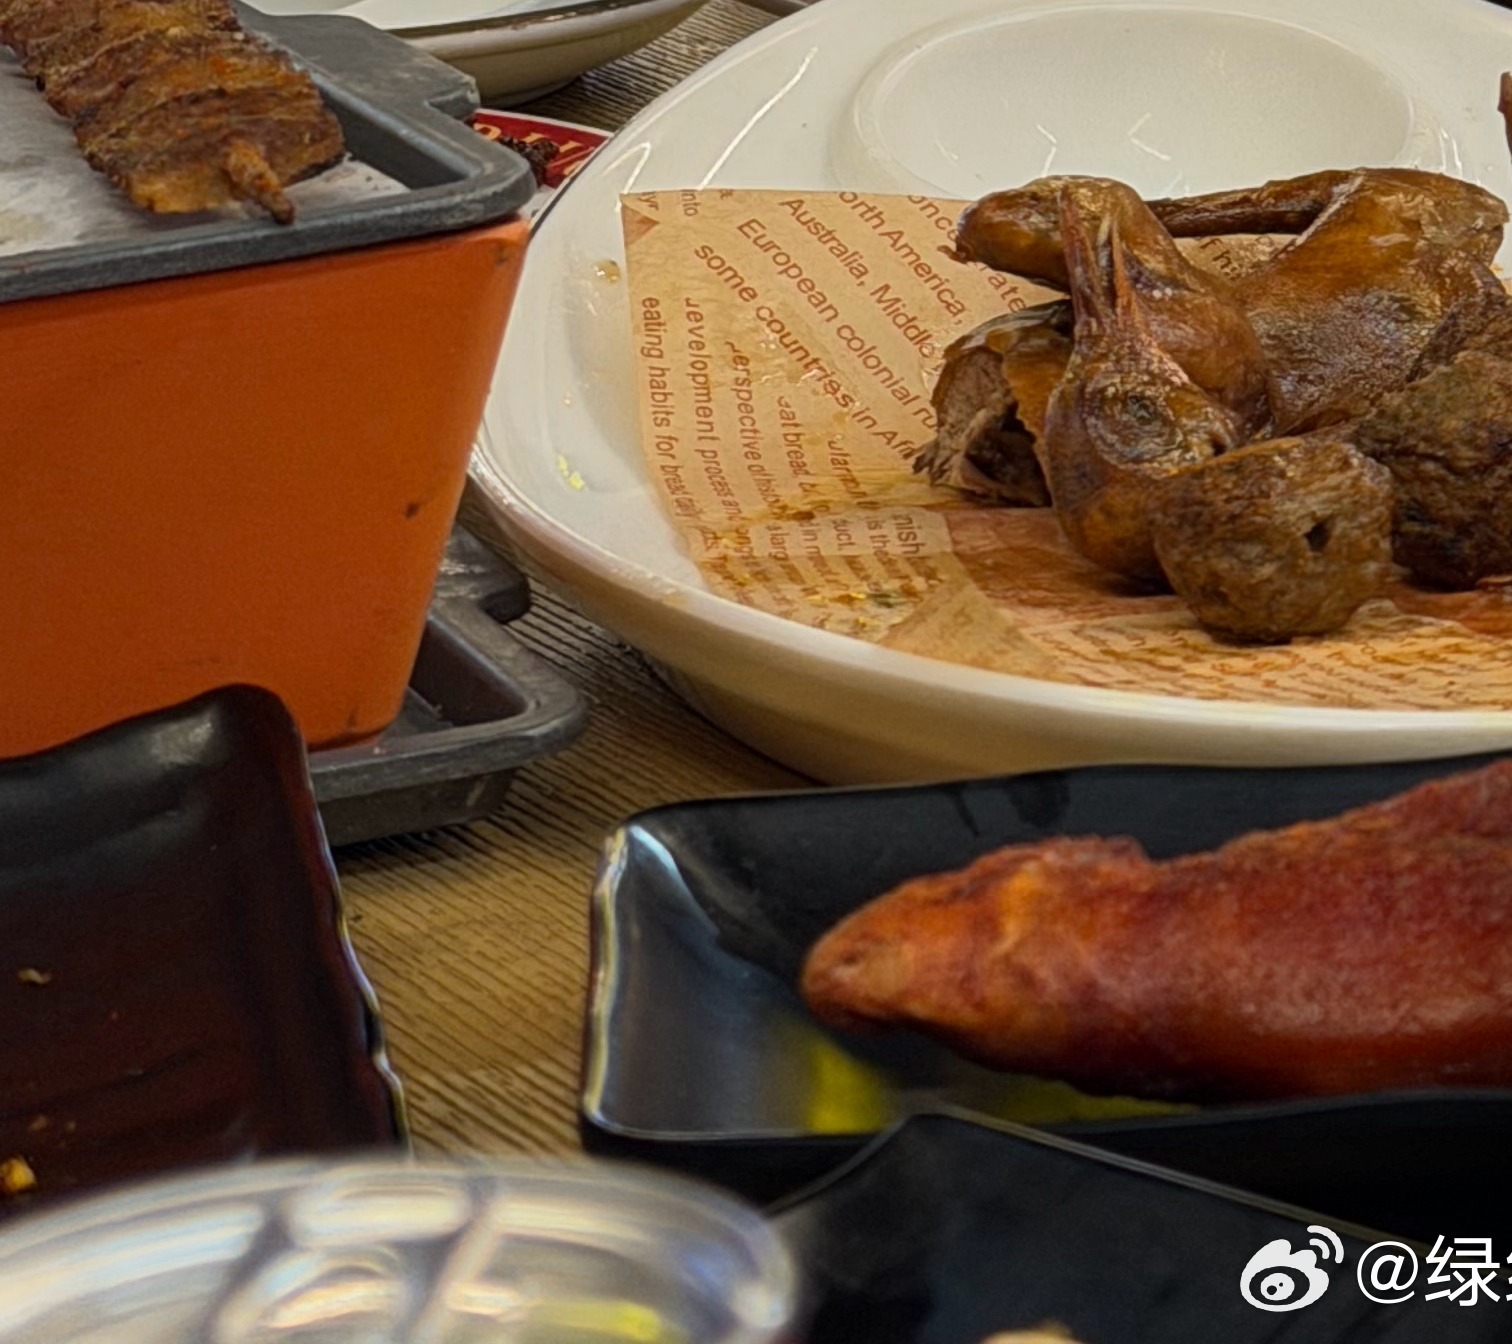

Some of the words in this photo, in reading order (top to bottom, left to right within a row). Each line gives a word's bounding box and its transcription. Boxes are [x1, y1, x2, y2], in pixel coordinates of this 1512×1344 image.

[778, 198, 870, 288] Australia,
[839, 191, 888, 230] orth
[878, 230, 967, 326] America,
[641, 297, 667, 359] eating
[694, 244, 759, 303] some
[755, 305, 857, 409] countries
[852, 407, 878, 430] in
[737, 218, 840, 323] European
[837, 324, 921, 407] colonial
[648, 365, 676, 428] habits
[655, 434, 679, 460] for
